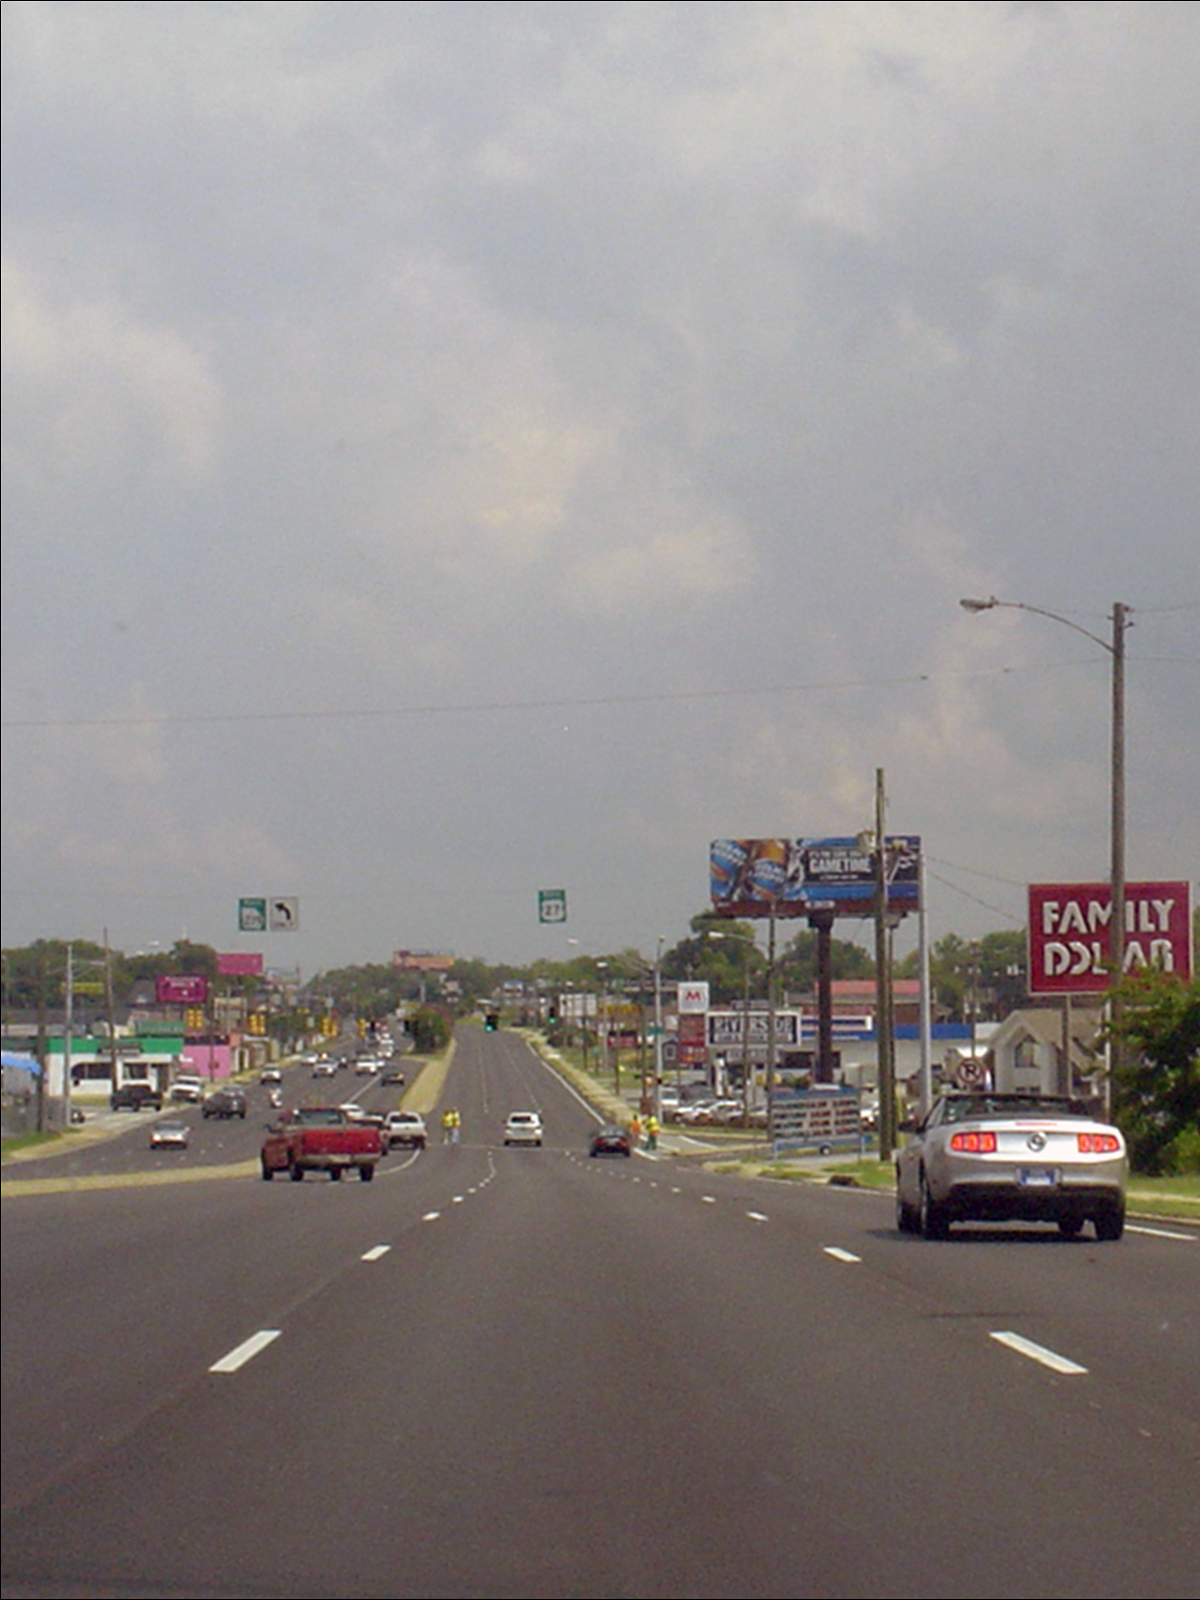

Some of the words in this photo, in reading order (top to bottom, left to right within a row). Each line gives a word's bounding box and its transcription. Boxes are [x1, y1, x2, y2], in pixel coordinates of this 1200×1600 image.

[810, 858, 872, 873] GAMETIME
[545, 903, 560, 916] 27
[1043, 900, 1174, 934] FAMILY
[1044, 939, 1174, 976] DOLAR
[714, 1016, 794, 1033] RIVRSDE
